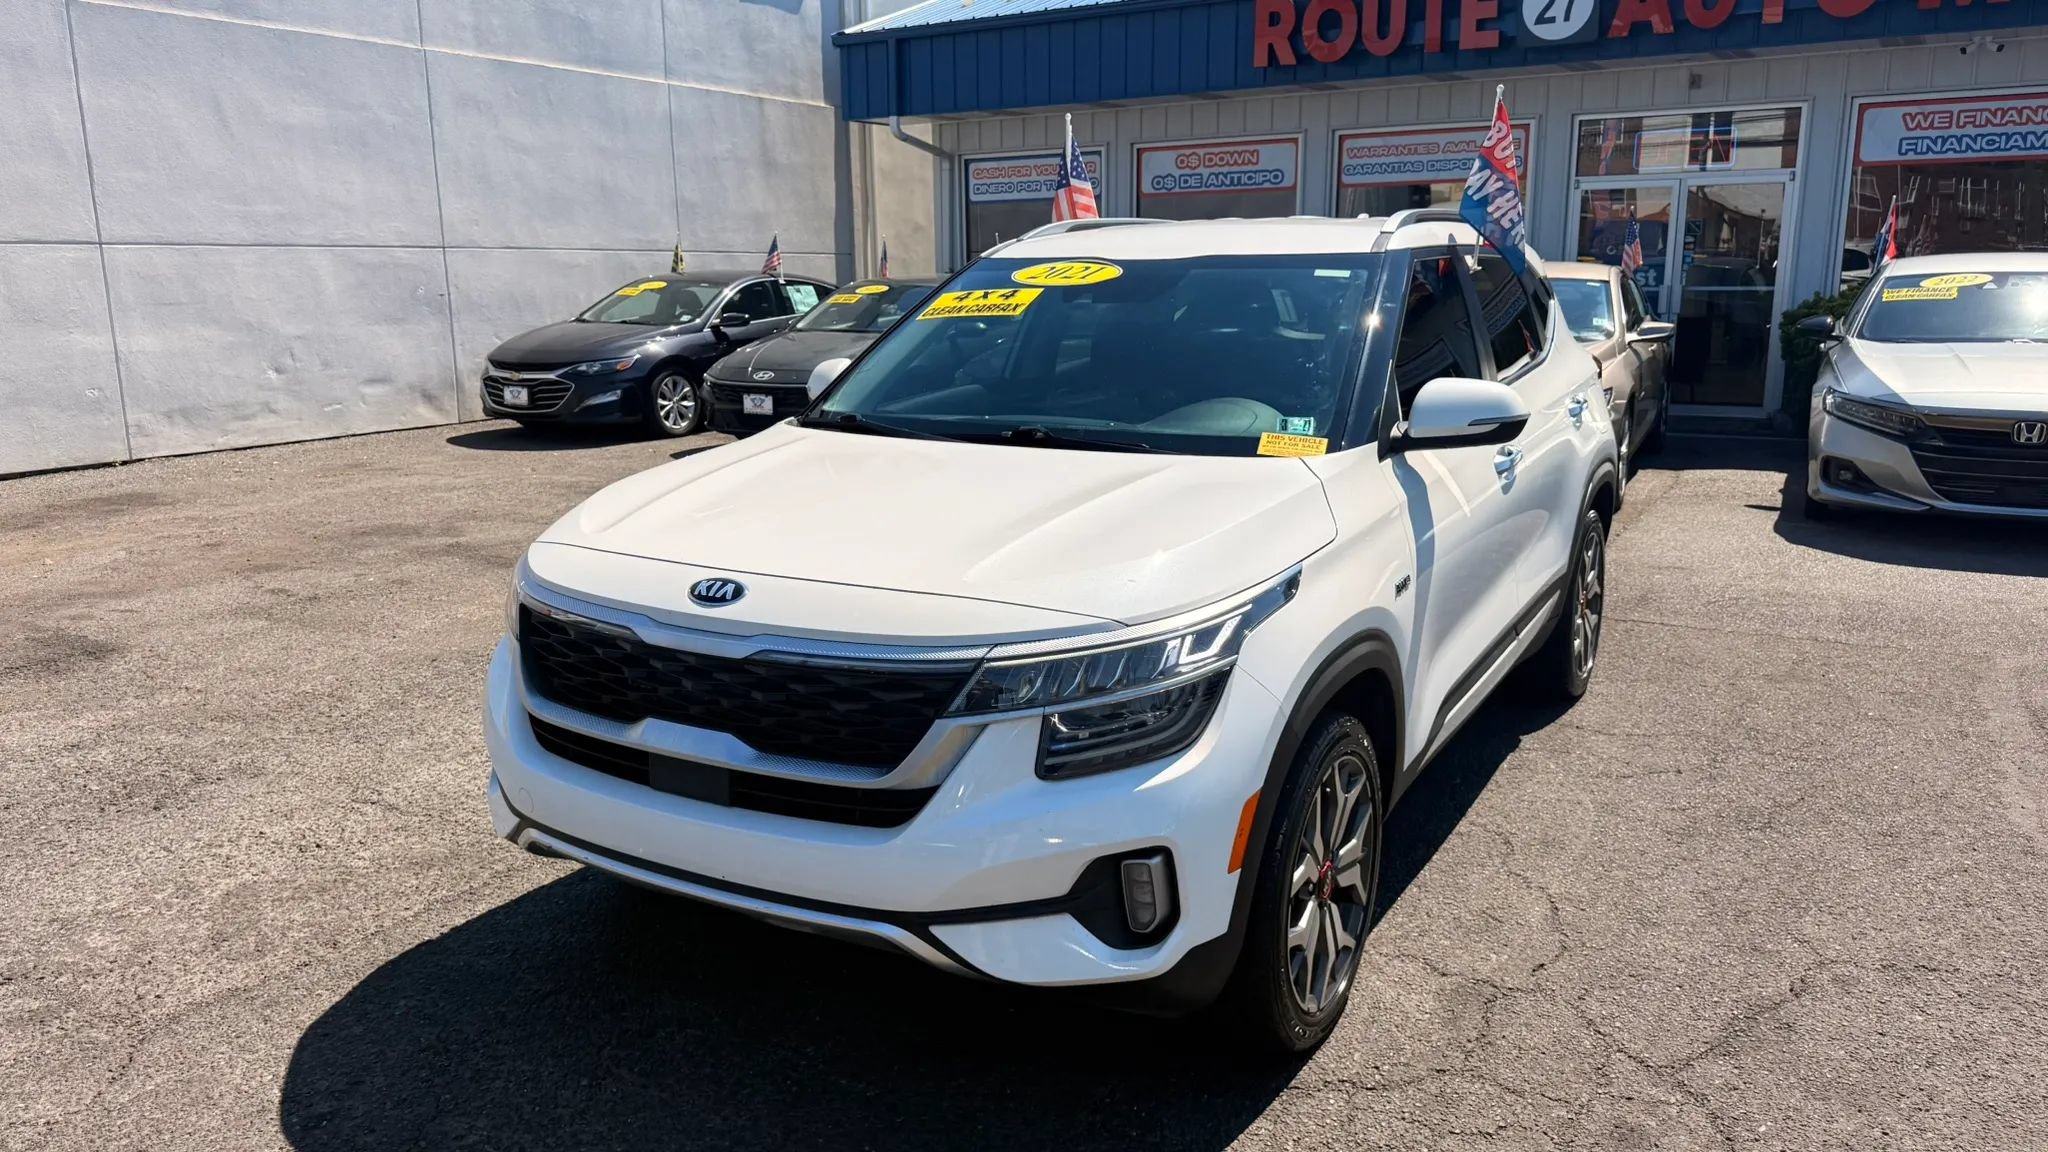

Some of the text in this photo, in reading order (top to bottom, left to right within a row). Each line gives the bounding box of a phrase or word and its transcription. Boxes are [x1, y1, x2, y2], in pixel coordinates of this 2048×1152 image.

[1253, 0, 1500, 68] ROUTE
[1607, 0, 1876, 38] AU
[1903, 111, 1953, 131] WE
[1203, 149, 1260, 168] DOWN
[1347, 141, 1440, 160] WARRANTIES
[974, 163, 1060, 180] CASH FOR YOU
[1344, 160, 1425, 176] GARANTIAS
[973, 181, 1015, 195] DINERO
[1016, 180, 1042, 193] POR
[1179, 173, 1203, 189] DE
[1205, 169, 1284, 188] ANTICIPO
[1026, 266, 1107, 280] 2021
[922, 303, 1023, 317] CLEAN CARFAX
[1266, 433, 1324, 445] THIS VEHICLE
[693, 580, 736, 600] KIA
